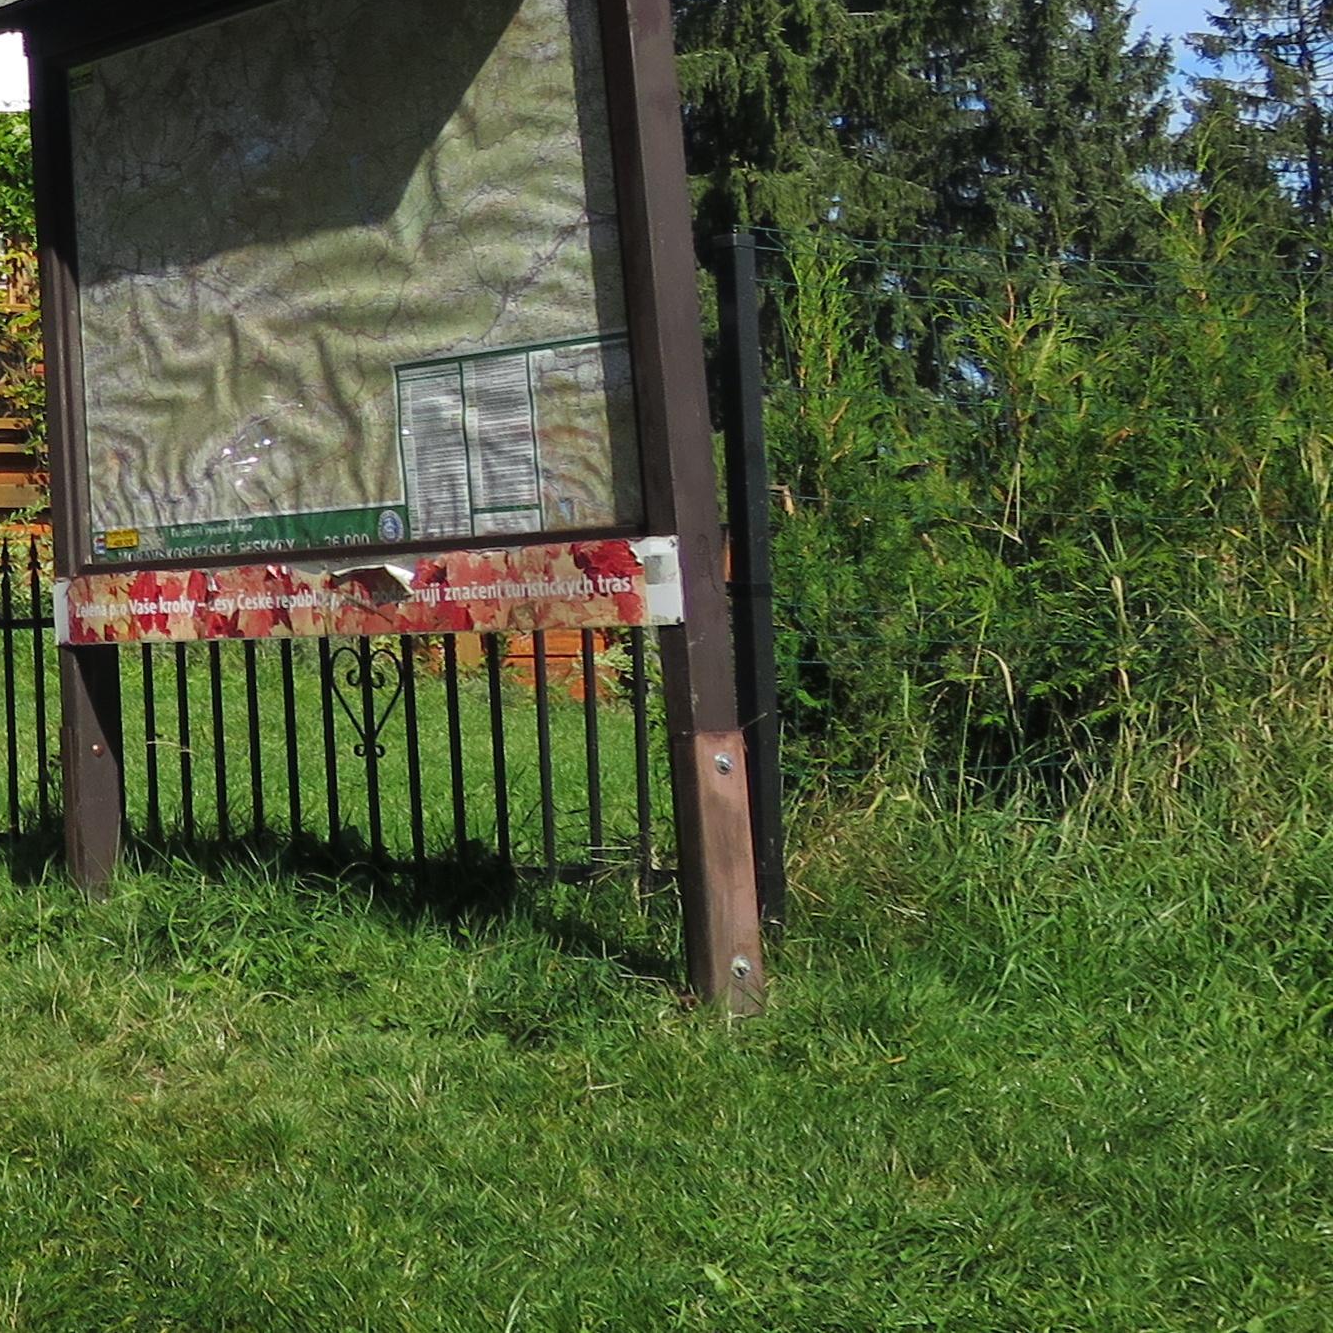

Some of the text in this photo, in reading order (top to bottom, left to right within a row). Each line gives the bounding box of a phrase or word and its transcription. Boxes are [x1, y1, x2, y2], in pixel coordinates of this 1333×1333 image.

[129, 597, 158, 615] Vaše
[158, 594, 196, 617] kroky
[236, 588, 274, 610] České
[596, 574, 632, 593] tras
